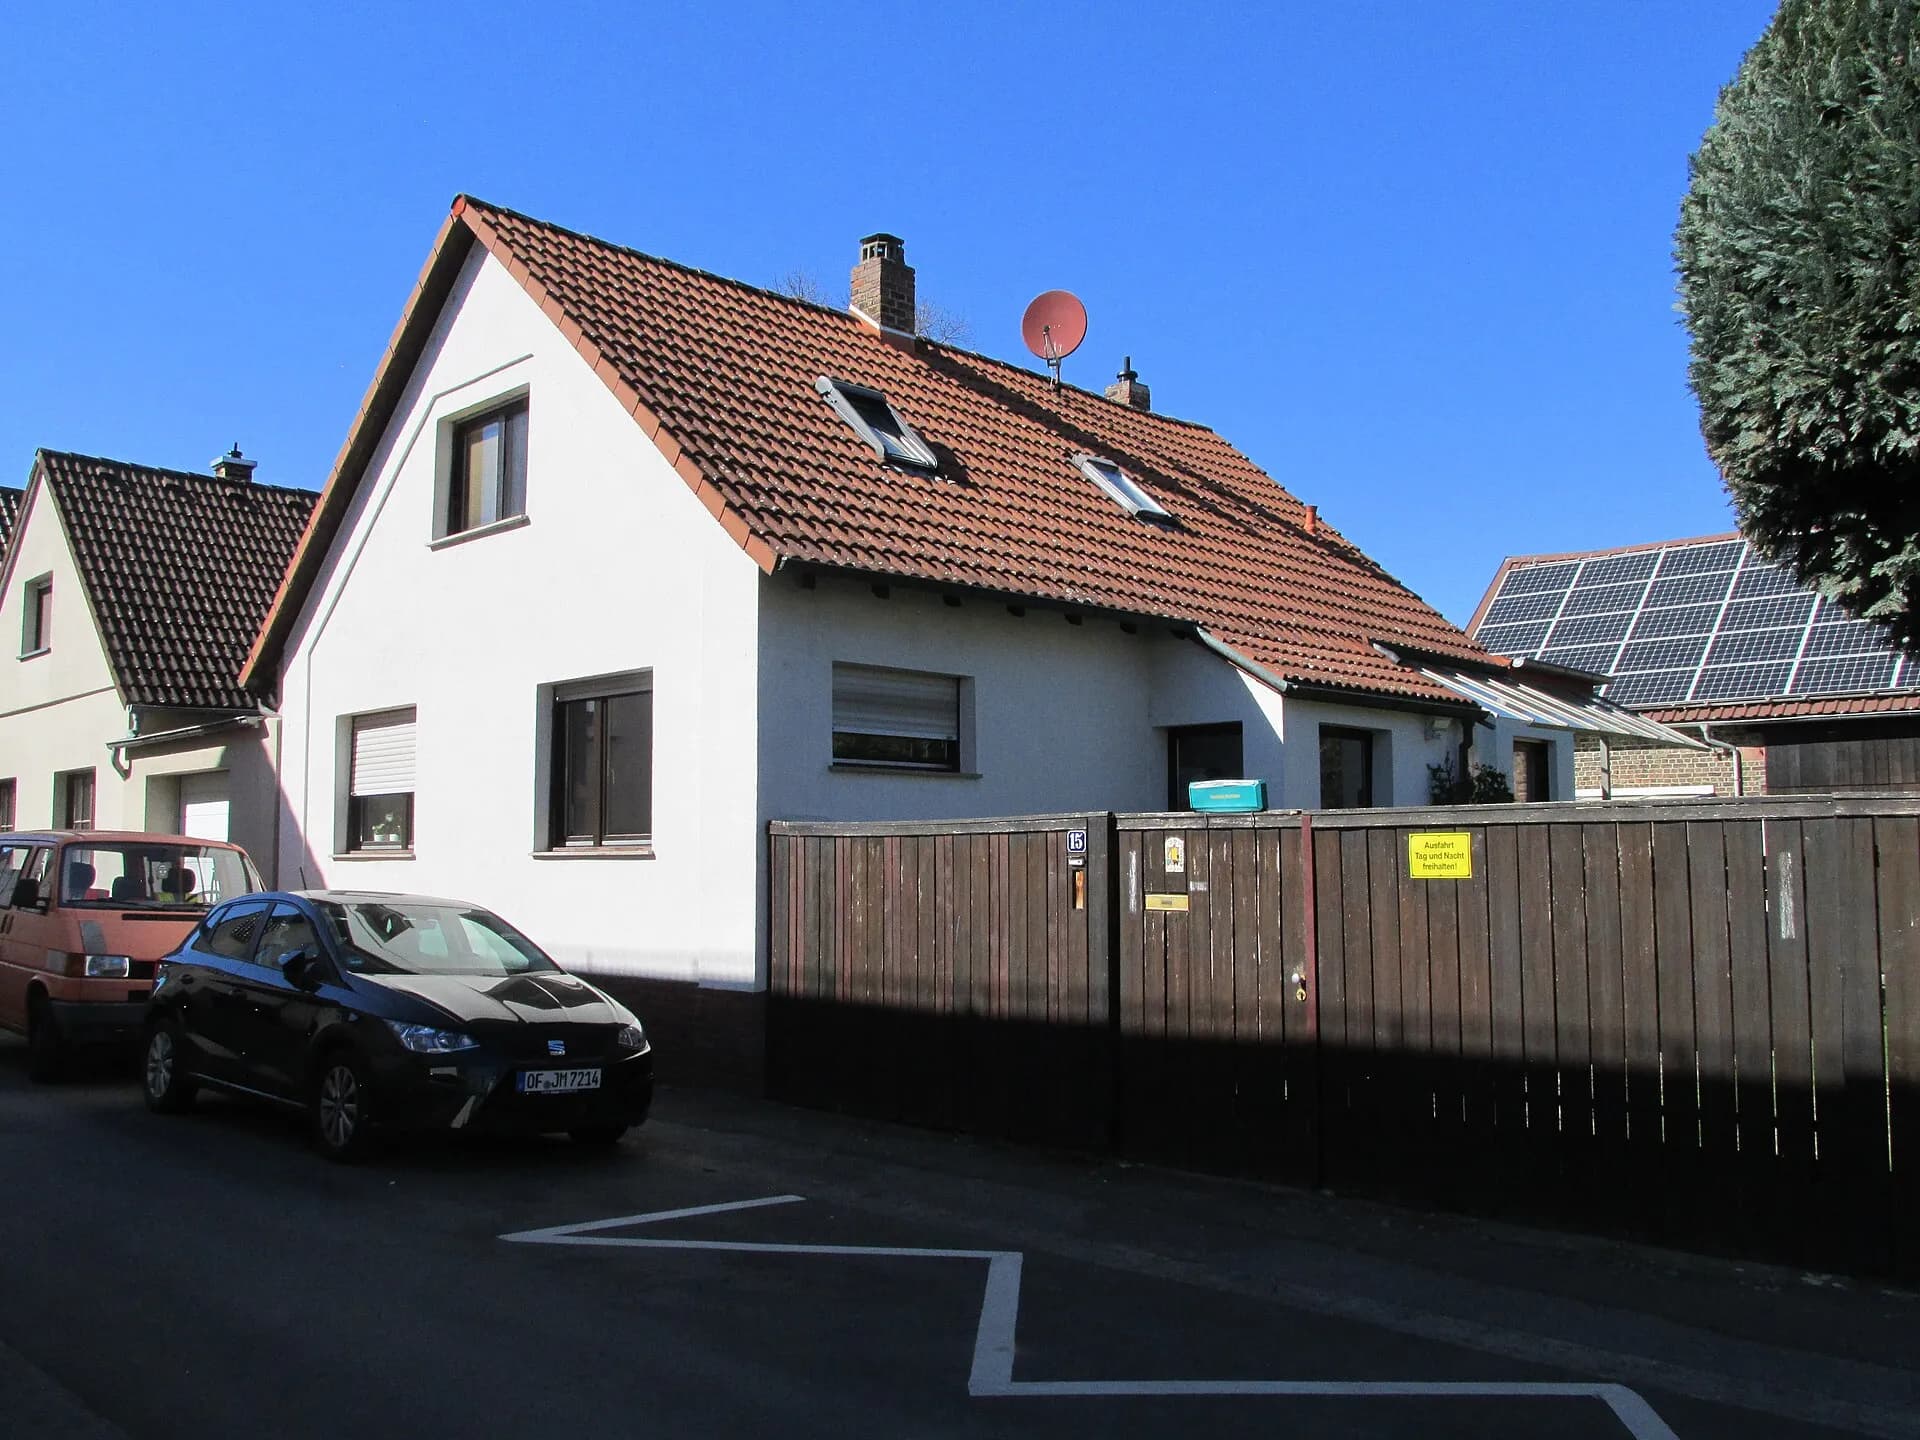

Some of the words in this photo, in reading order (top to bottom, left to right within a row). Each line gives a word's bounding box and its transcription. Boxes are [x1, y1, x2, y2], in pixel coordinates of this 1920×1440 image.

[1070, 832, 1083, 850] 15
[1424, 841, 1454, 849] Ausfahrt
[1415, 852, 1428, 861] Tag
[1429, 852, 1443, 860] und
[1444, 852, 1465, 860] Nacht
[527, 1073, 544, 1089] OF
